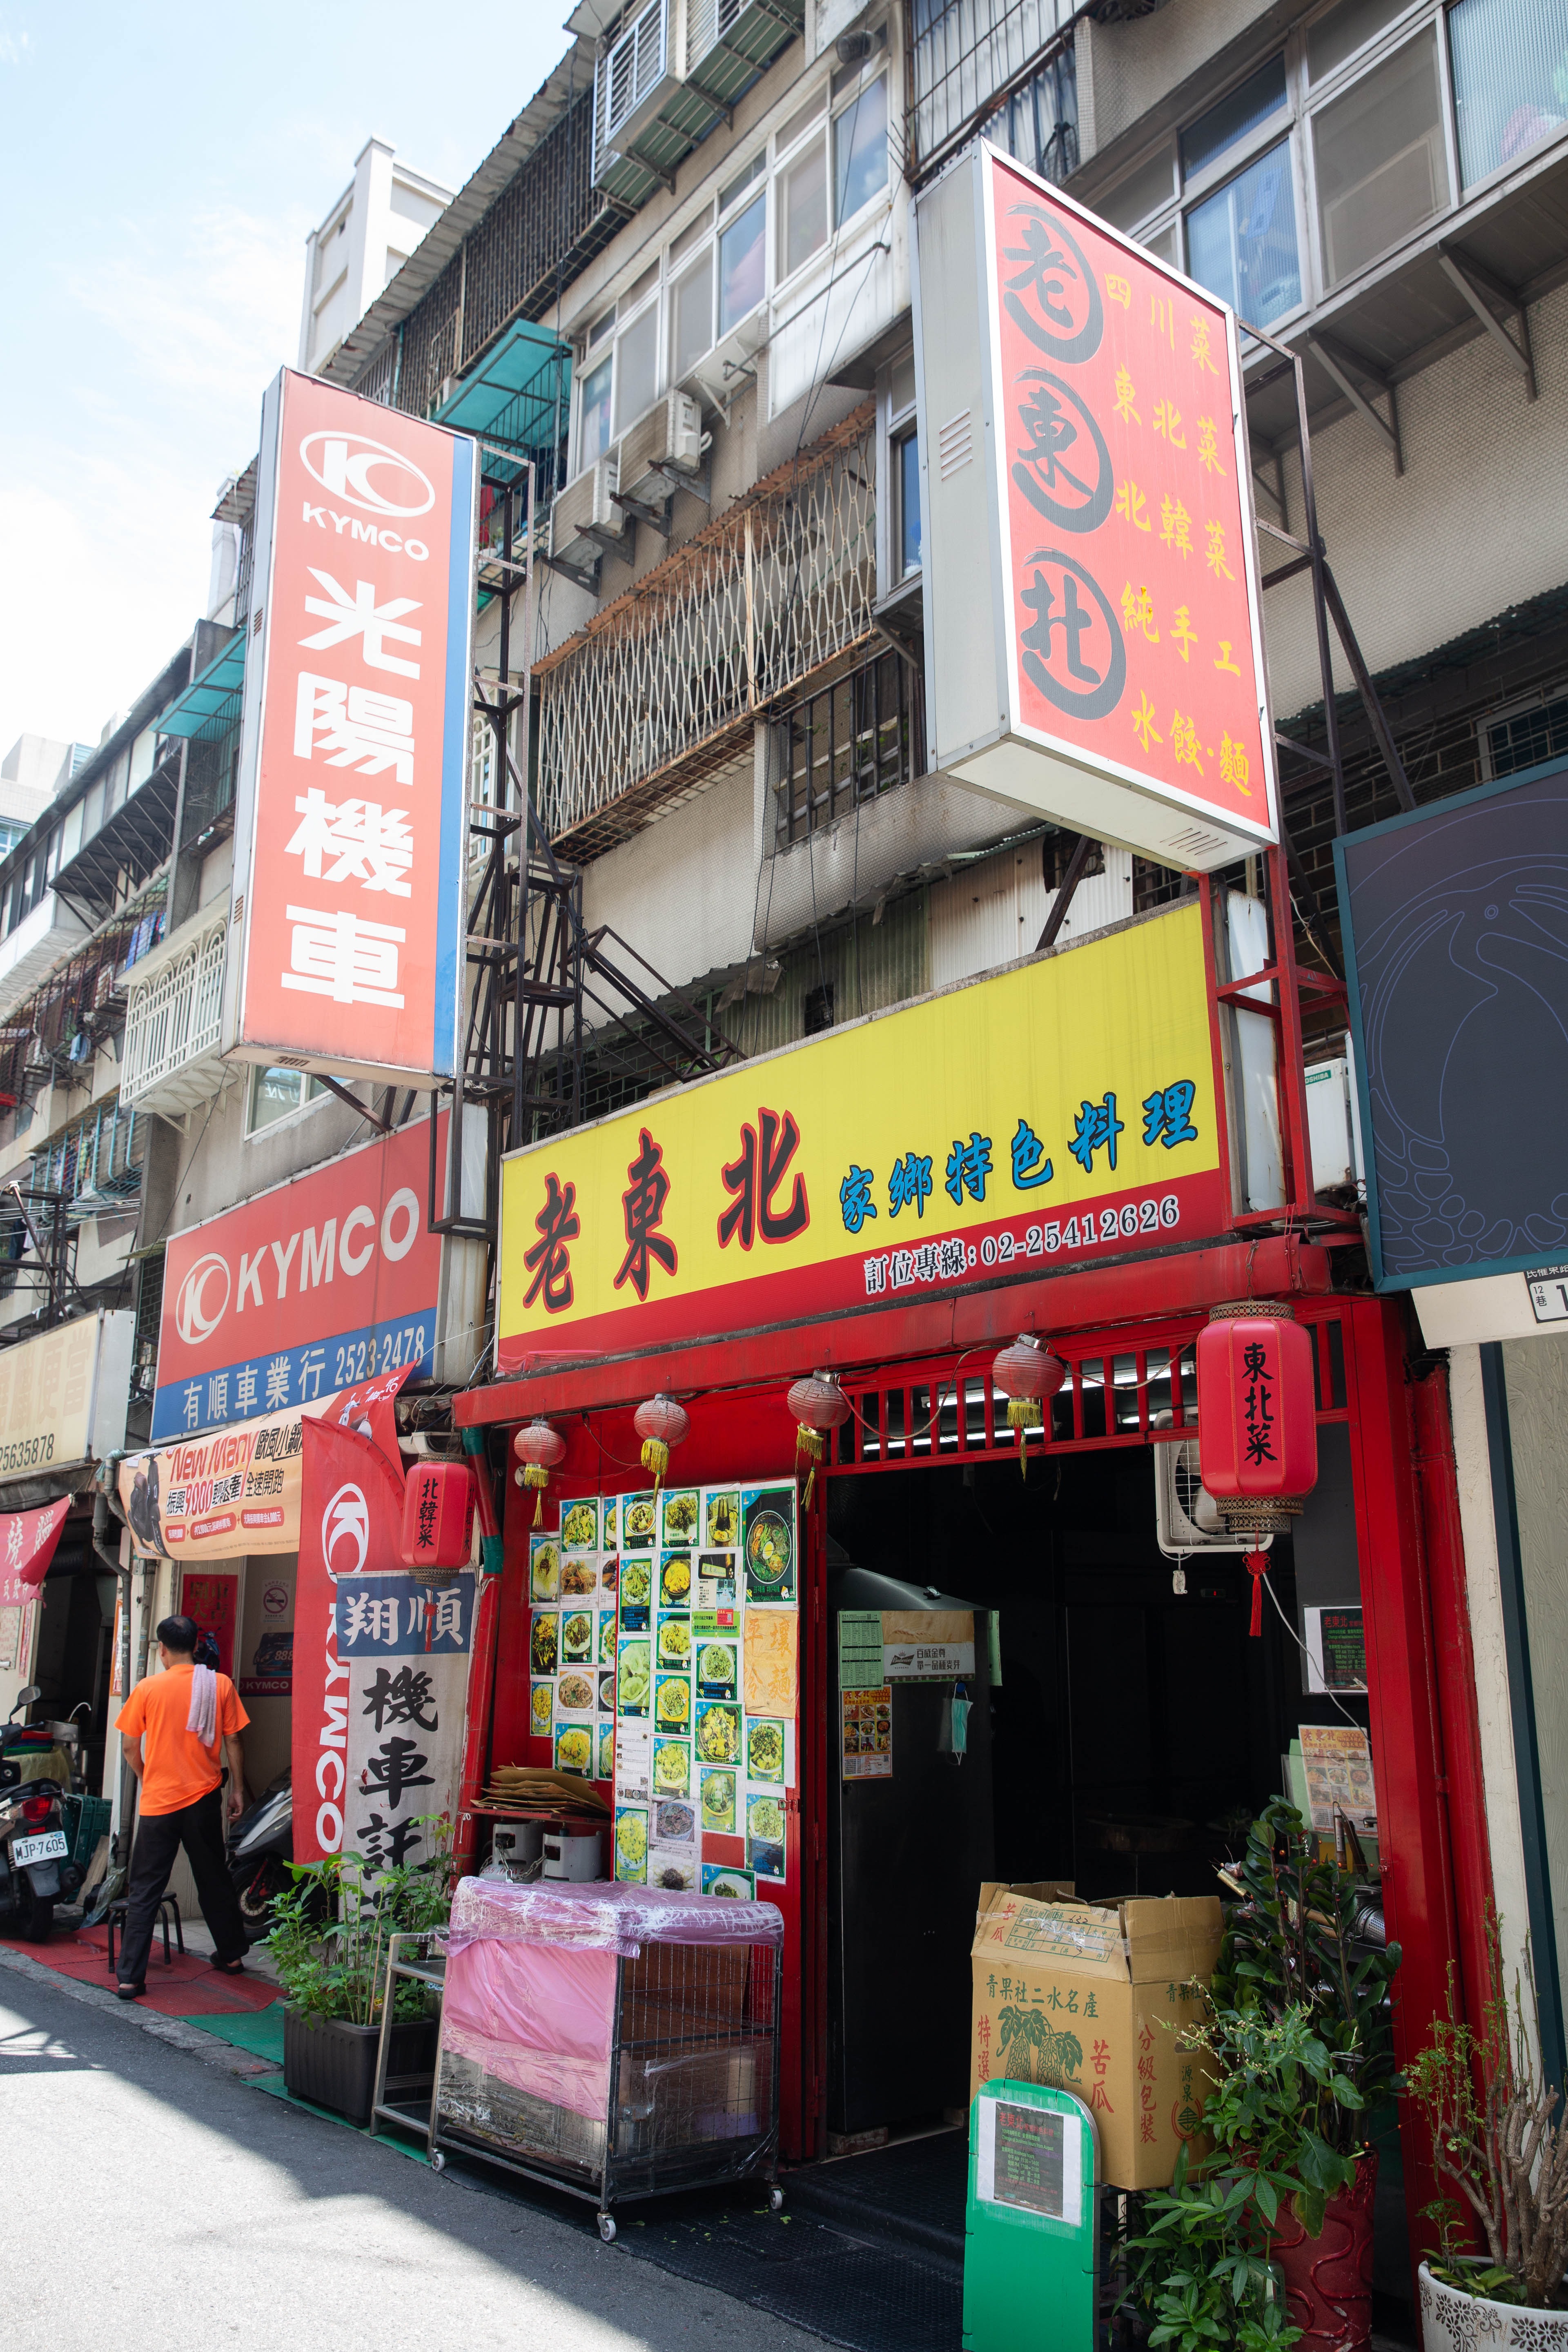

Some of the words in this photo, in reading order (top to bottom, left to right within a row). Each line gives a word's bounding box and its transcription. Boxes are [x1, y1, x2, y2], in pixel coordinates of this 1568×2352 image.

[1105, 273, 1220, 376] 四川菜
[1003, 218, 1101, 687] 老東北
[1114, 362, 1228, 477] 東北菜
[302, 501, 430, 562] KYMCO
[1116, 480, 1236, 581] 北韓菜
[1121, 585, 1242, 679] 純手工
[281, 566, 422, 1008] 光陽機車
[1305, 1072, 1329, 1084] OSHIBA
[838, 1078, 1200, 1234] 家鄉特色料理
[522, 1105, 811, 1315] 老東北
[236, 1187, 420, 1313] KYMCO
[183, 1347, 325, 1429] 有順車業行
[336, 1325, 424, 1381] 2523-2478
[1242, 1342, 1278, 1466] 東北菜
[245, 1468, 285, 1497] 全速開跑
[416, 1478, 439, 1549] 北韓菜
[342, 1587, 464, 1648] 翔順
[917, 1648, 946, 1658] 百威金尊
[1324, 1615, 1348, 1628] 老東北
[246, 1681, 289, 1689] KYMCO
[917, 1660, 960, 1670] 單一品種麥芽
[986, 1973, 1099, 2018] 青果社二水名產
[1089, 2039, 1114, 2114] 苦瓜
[1137, 2024, 1158, 2144] 分級包裝
[1181, 2064, 1194, 2103] 源泉
[999, 2111, 1023, 2130] 老東北
